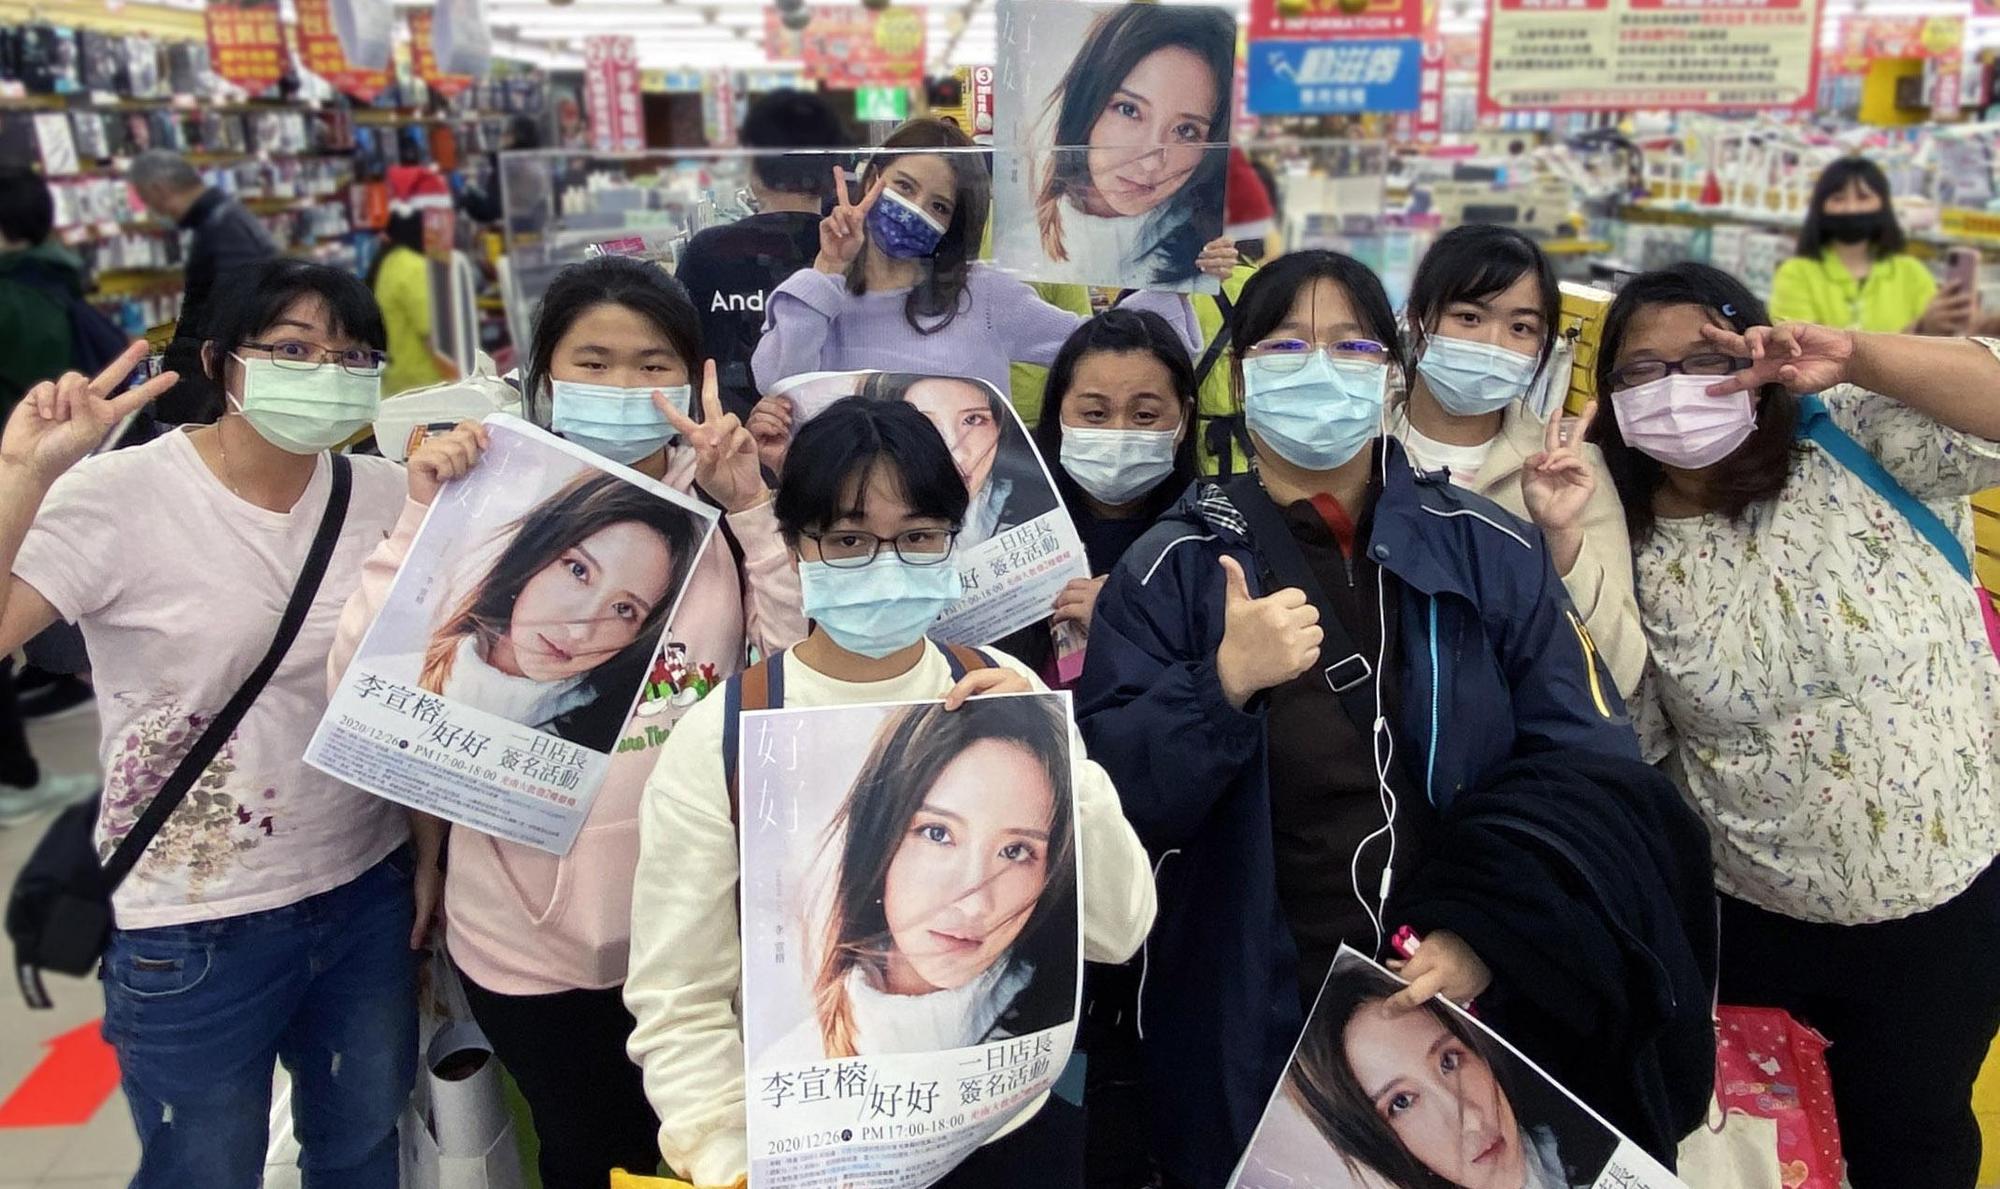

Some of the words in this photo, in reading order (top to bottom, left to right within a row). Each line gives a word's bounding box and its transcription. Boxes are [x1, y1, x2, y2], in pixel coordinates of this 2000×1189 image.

[1283, 16, 1391, 31] INFORMATION
[984, 517, 1053, 553] 一日店長
[990, 534, 1060, 578] 簽名活動
[496, 748, 580, 790] 簽名活動
[512, 732, 589, 771] 一日店長
[959, 1031, 1053, 1072] 一日店長
[959, 1057, 1050, 1106] 簽名活動
[862, 1127, 884, 1141] PM
[888, 1114, 965, 1138] 17:00-18:00
